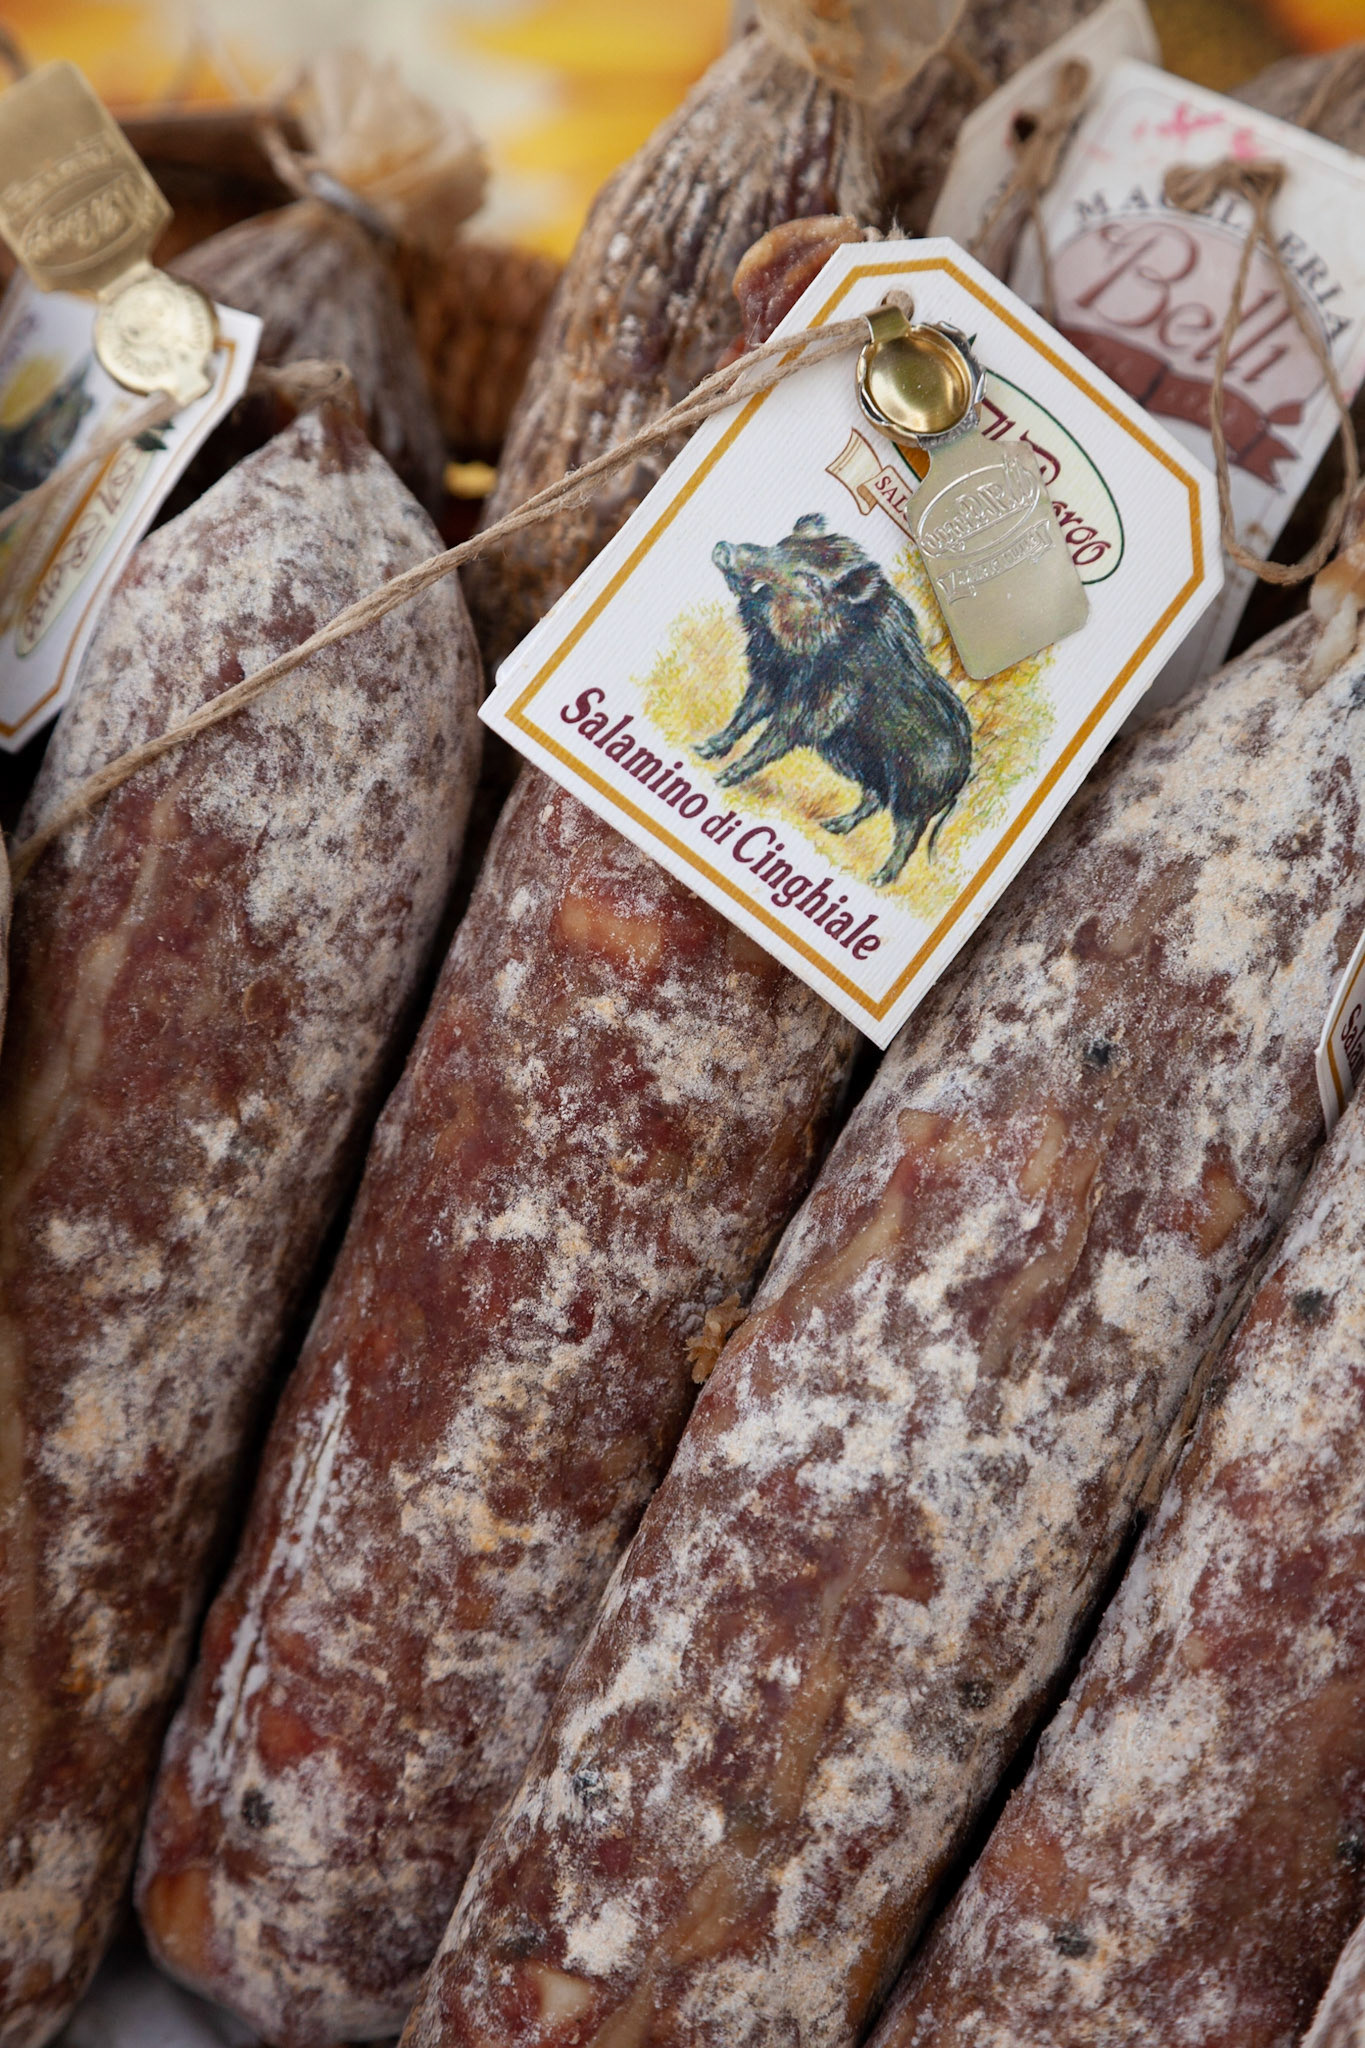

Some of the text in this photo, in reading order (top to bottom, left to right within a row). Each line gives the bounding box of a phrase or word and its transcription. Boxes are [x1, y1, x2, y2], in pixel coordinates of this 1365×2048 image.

[1075, 187, 1353, 344] MALERIA
[875, 475, 908, 522] SAL
[561, 687, 881, 960] Salamino di Cinghiale
